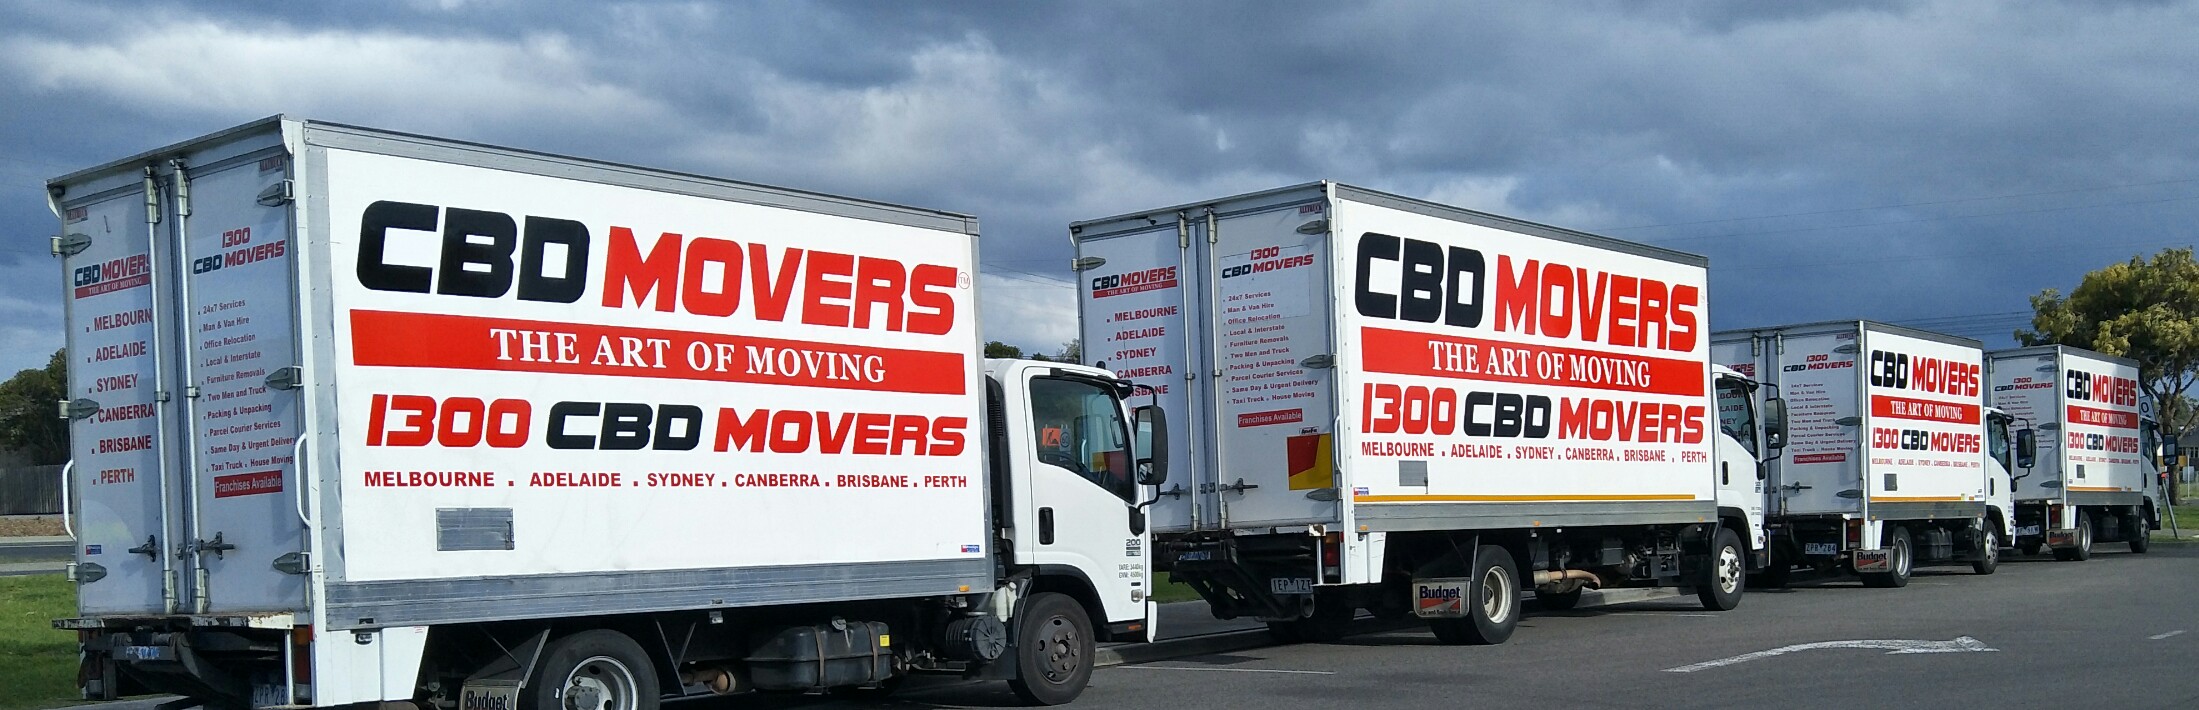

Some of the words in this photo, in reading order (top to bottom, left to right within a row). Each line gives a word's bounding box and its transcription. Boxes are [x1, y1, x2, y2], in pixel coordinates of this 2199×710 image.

[222, 227, 250, 248] 1300
[193, 254, 222, 274] CBD
[225, 240, 286, 268] MOVERS
[1250, 246, 1280, 260] 1300
[74, 264, 100, 286] CBD
[356, 200, 590, 304] CBD
[601, 226, 958, 336] MOVERS
[1222, 264, 1252, 278] CBD
[1252, 254, 1314, 273] MOVERS
[101, 284, 110, 292] ART
[112, 281, 119, 290] OF
[120, 278, 141, 288] MOVING
[1092, 274, 1119, 290] CBD
[1121, 266, 1176, 286] MOVERS
[1354, 231, 1485, 329] CBD
[1494, 254, 1698, 353] MOVERS
[203, 304, 218, 314] 24x7
[220, 300, 246, 311] Services
[1114, 306, 1178, 322] MELBOURNE
[204, 323, 215, 332] Man
[218, 321, 222, 329] &
[237, 316, 250, 326] Hire
[204, 340, 222, 349] Office
[224, 334, 256, 346] Relocation
[1116, 327, 1165, 340] ADELAIDE
[96, 341, 146, 362] ADELAIDE
[206, 356, 222, 366] Local
[224, 355, 228, 363] &
[231, 350, 260, 361] Interstate
[490, 328, 581, 365] THE
[591, 336, 671, 370] ART
[686, 341, 735, 373] OF
[745, 345, 886, 383] MOVING
[1116, 347, 1156, 360] SYDNEY
[1806, 354, 1828, 362] 1300
[1116, 365, 1172, 378] CANBERRA
[1428, 340, 1480, 374] THE
[1484, 346, 1531, 379] ART
[1540, 351, 1565, 380] OF
[1568, 354, 1650, 388] MOVING
[1808, 360, 1854, 370] MOVERS
[207, 374, 234, 384] Furniture
[236, 368, 266, 378] Removals
[1870, 350, 1908, 389] CBD
[1912, 356, 1980, 397] MOVERS
[97, 374, 138, 392] SYDNEY
[2067, 369, 2090, 400] CBD
[2093, 374, 2136, 406] MOVERS
[208, 393, 220, 401] Two
[222, 392, 234, 400] Men
[236, 388, 247, 398] and
[249, 385, 266, 394] Truck
[98, 403, 155, 423] CANBERRA
[208, 410, 232, 420] Packing
[234, 407, 238, 416] &
[240, 404, 272, 415] Unpacking
[1238, 415, 1272, 424] Franchises
[1273, 412, 1302, 421] Available
[1361, 382, 1457, 434] 1300
[1463, 391, 1551, 439] CBD
[1558, 397, 1705, 444] MOVERS
[1890, 400, 1906, 414] THE
[1908, 403, 1922, 416] ART
[1924, 404, 1933, 417] OF
[1934, 404, 1962, 420] MOVING
[210, 427, 228, 436] Parcel
[230, 424, 252, 434] Courier
[254, 420, 280, 430] Services
[366, 394, 532, 448] 1300
[546, 400, 703, 451] CBD
[713, 408, 968, 457] MOVERS
[100, 435, 152, 454] BRISBANE
[210, 446, 226, 454] Same
[228, 444, 240, 452] Day
[248, 440, 269, 450] Urgent
[271, 436, 297, 446] Delivery
[1872, 427, 1898, 449] 1300
[1901, 429, 1928, 450] CBD
[1930, 432, 1980, 453] MOVERS
[2068, 432, 2084, 449] 1300
[2086, 434, 2104, 450] CBD
[2106, 435, 2138, 454] MOVERS
[1362, 441, 1434, 457] MELBOURNE
[1450, 444, 1502, 459] ADELAIDE
[1516, 446, 1554, 460] SYDNEY
[1566, 448, 1614, 462] CANBERRA
[1624, 450, 1666, 462] BRISBANE
[1681, 451, 1707, 463] PERTH
[211, 463, 224, 472] Taxi
[226, 460, 242, 470] Truck
[250, 458, 270, 467] House
[271, 455, 294, 464] Moving
[100, 468, 134, 484] PERTH
[215, 480, 250, 492] Franchises
[252, 475, 282, 489] Available
[364, 471, 495, 488] MELBOURNE
[530, 472, 622, 488] ADELAIDE
[647, 473, 715, 488] SYDNEY
[734, 474, 820, 489] CANBERRA
[837, 474, 909, 489] BRISBANE
[924, 475, 967, 489] PERTH
[1857, 552, 1886, 561] Budget
[1420, 586, 1461, 602] Budget
[464, 690, 510, 710] Budget
